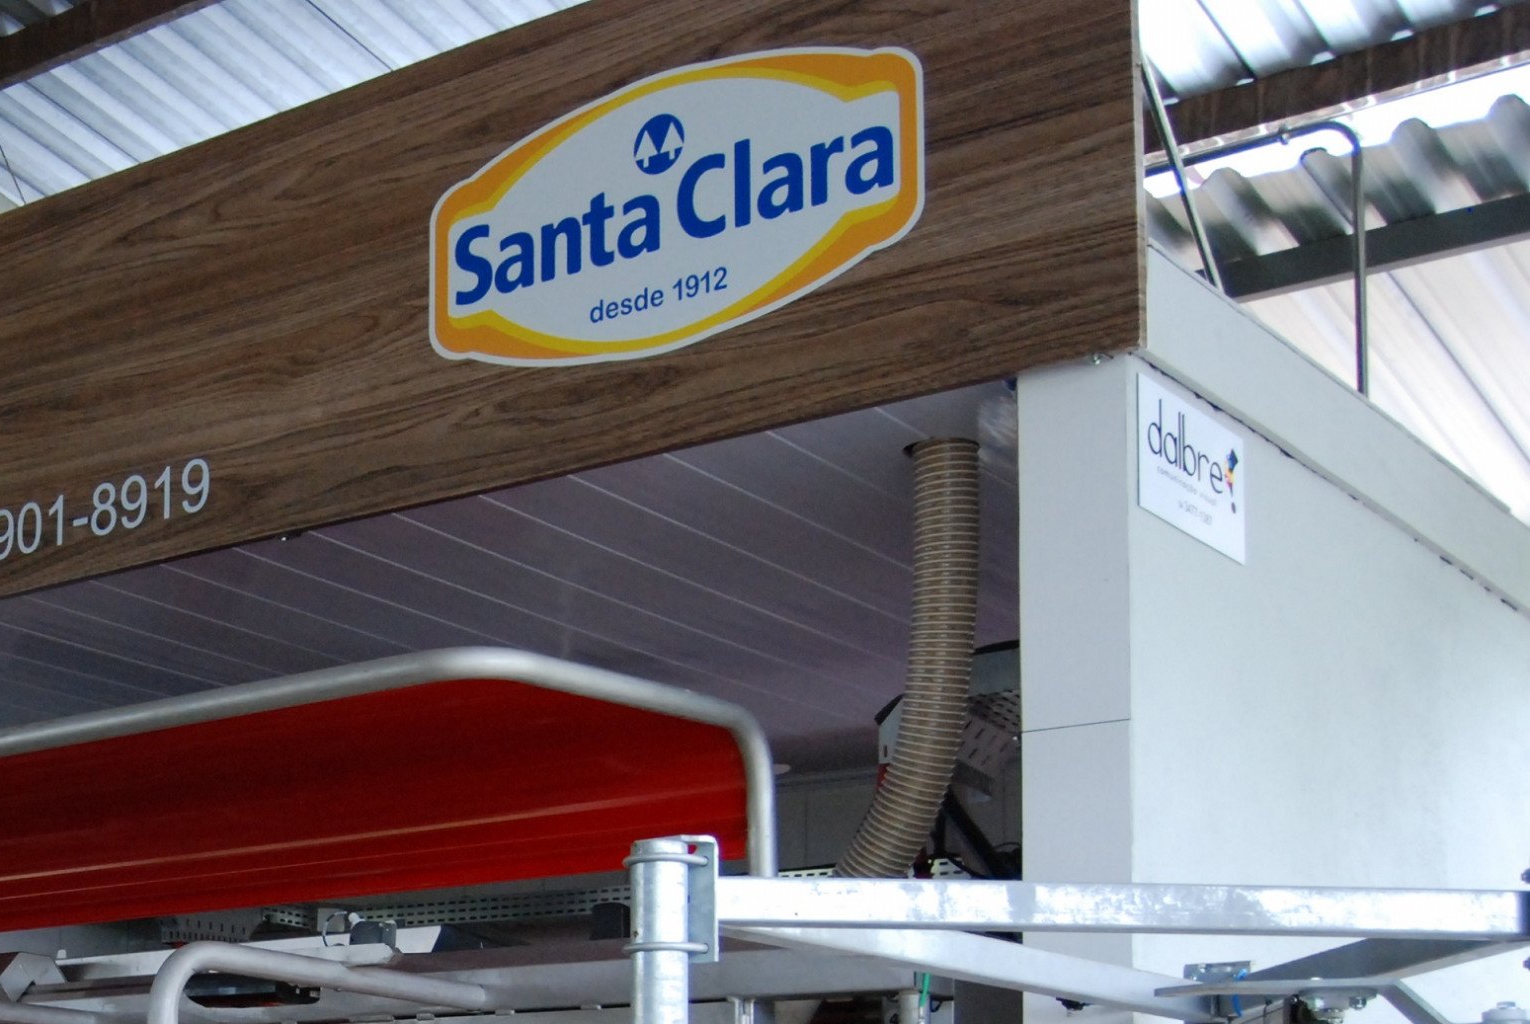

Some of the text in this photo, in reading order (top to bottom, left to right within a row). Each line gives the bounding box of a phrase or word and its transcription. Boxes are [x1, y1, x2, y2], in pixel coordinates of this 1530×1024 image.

[455, 124, 895, 306] Santa Clara
[588, 266, 729, 324] desde 1912
[1147, 398, 1224, 494] dalbre
